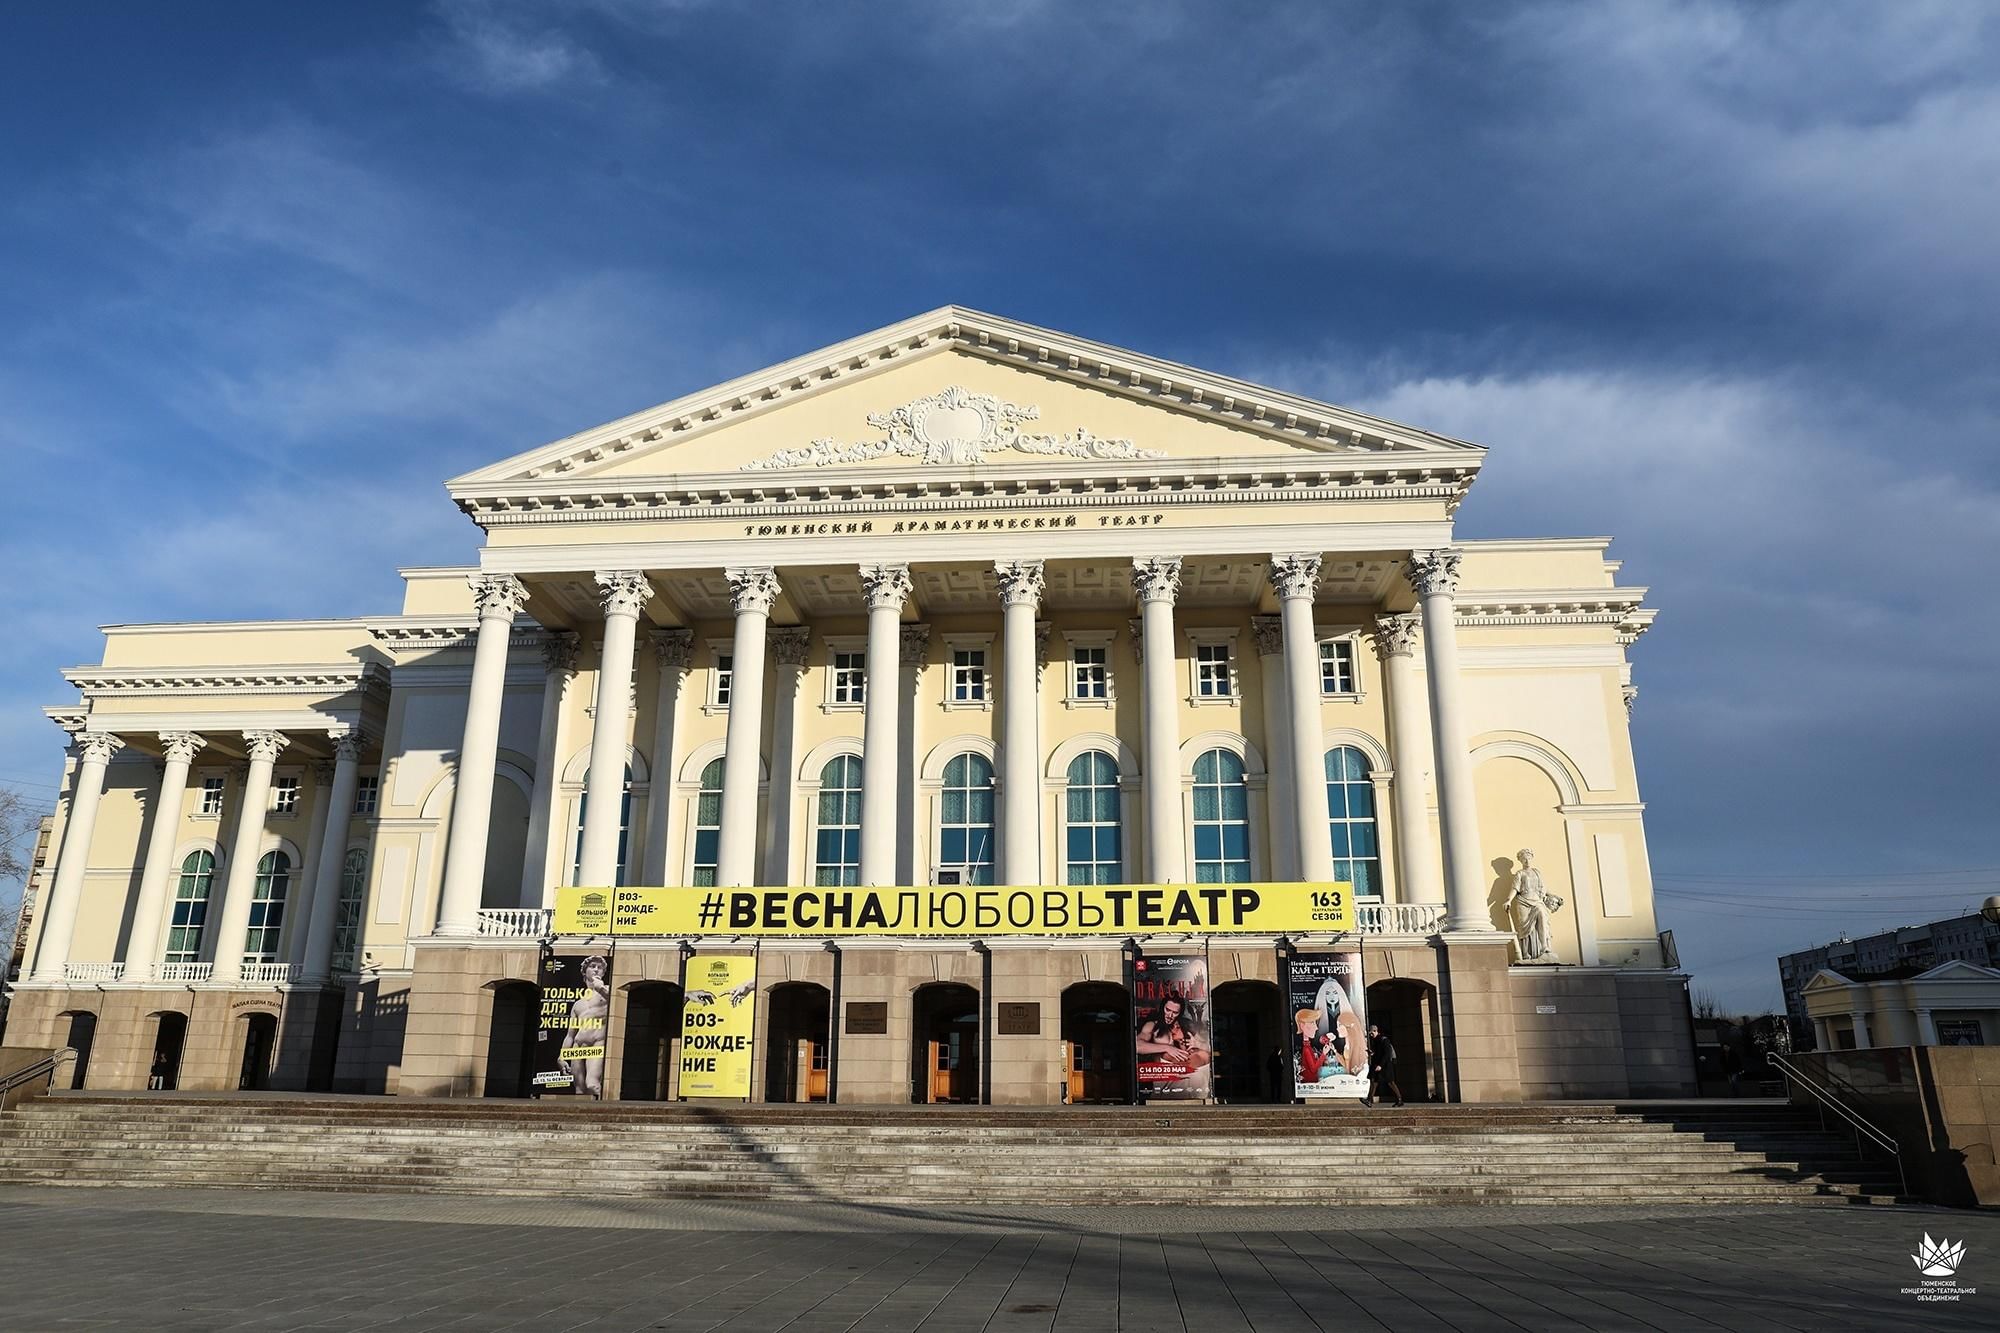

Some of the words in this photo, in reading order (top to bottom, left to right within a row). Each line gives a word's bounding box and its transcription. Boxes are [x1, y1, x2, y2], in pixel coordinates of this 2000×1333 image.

[744, 520, 873, 536] ТЮМЕНСКИЙ
[892, 514, 1077, 533] ДРАМАТИЧЕСКИЙ
[1098, 514, 1164, 527] ТЕАТР
[618, 892, 643, 901] ВОЗ-
[1310, 891, 1341, 907] 163
[617, 904, 658, 914] РОЖДЕ-
[616, 917, 637, 925] НИЕ
[1312, 912, 1342, 921] СЕЗОН
[1291, 967, 1311, 975] КАЯ
[543, 987, 593, 1000] ТОЛЬКО
[541, 1002, 567, 1015] ДЛЯ
[539, 1017, 602, 1029] ЖЕНЩИН
[685, 1013, 724, 1028] ВОЗ-
[684, 1035, 753, 1052] РОЖДЕ-
[562, 1048, 603, 1058] CENSORSHIP
[682, 1057, 716, 1072] НИЕ
